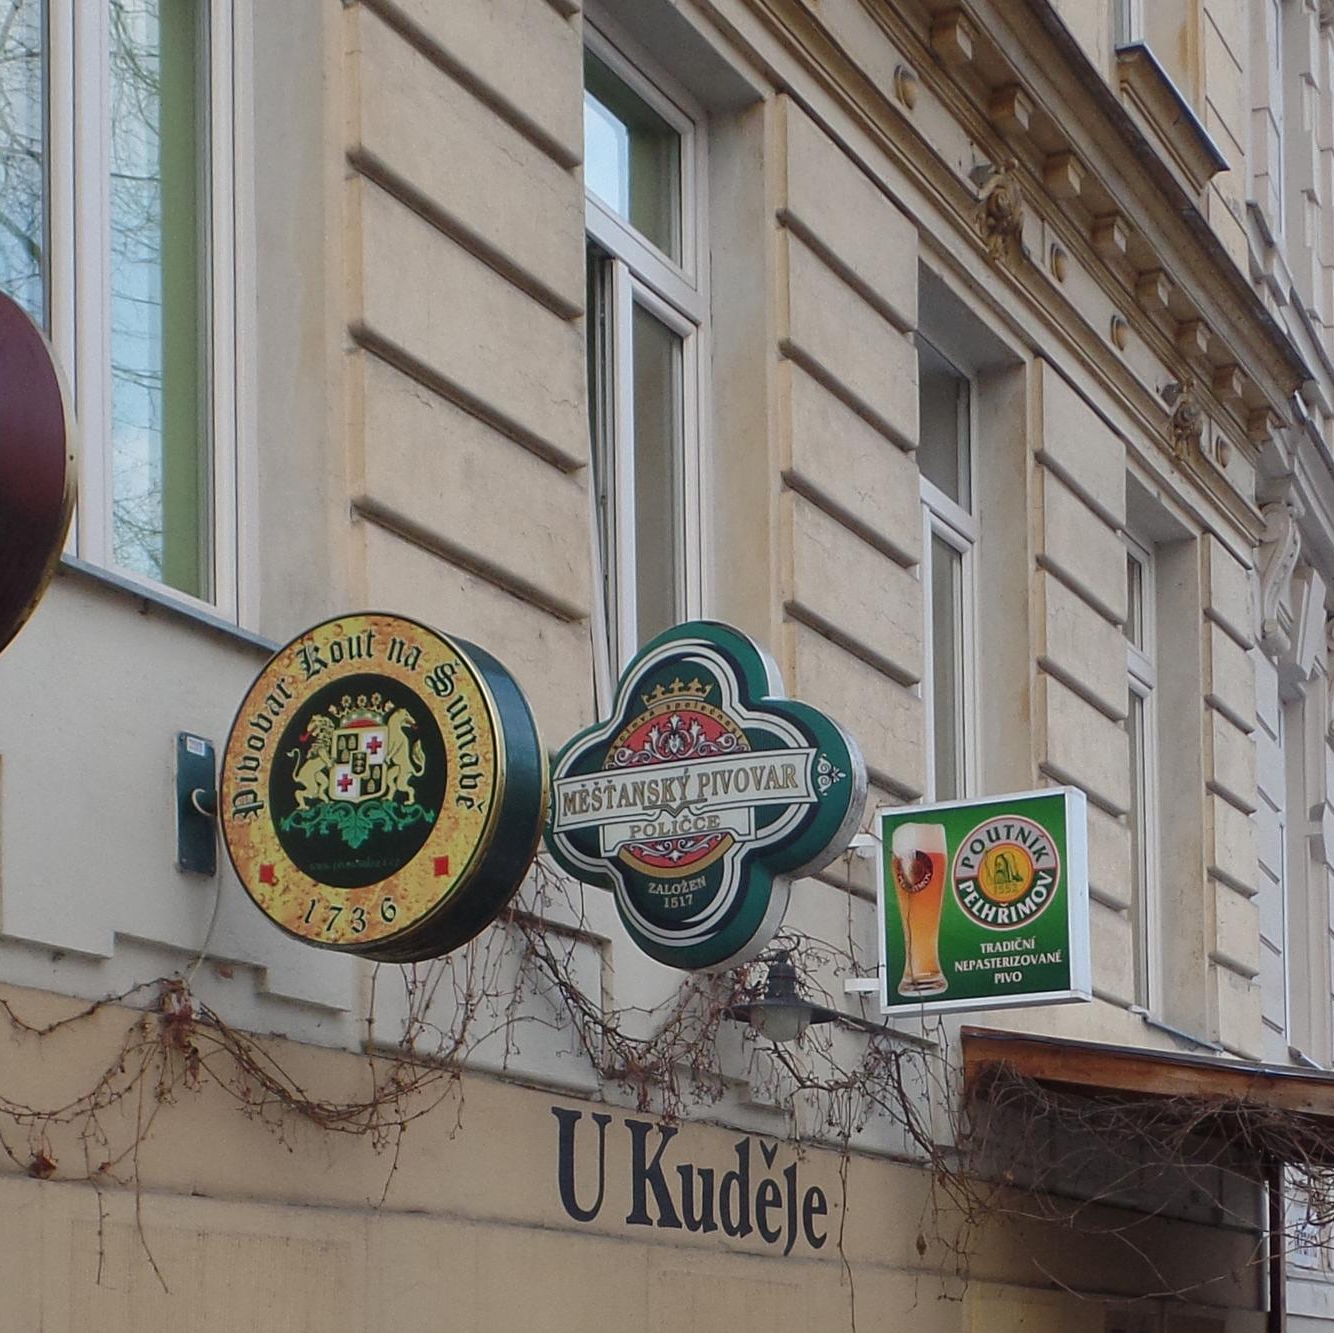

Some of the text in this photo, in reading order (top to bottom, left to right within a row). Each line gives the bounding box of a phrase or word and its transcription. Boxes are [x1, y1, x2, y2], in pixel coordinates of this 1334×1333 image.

[295, 629, 376, 680] Kout
[387, 639, 423, 671] na
[562, 762, 798, 817] MĚŠŤANSKÝ PIVOVAR
[629, 814, 720, 839] POLIČCE
[962, 822, 1050, 869] POUTNÍK
[648, 875, 707, 896] ZALOŽEN
[959, 870, 1053, 925] PELHŘIMOV
[304, 896, 397, 934] 1736
[954, 950, 1062, 973] NEPASTERIZOVANÉ
[980, 936, 1036, 954] TRADIČNÍ
[994, 972, 1023, 985] PIVO
[551, 1106, 827, 1256] U Kuděje
